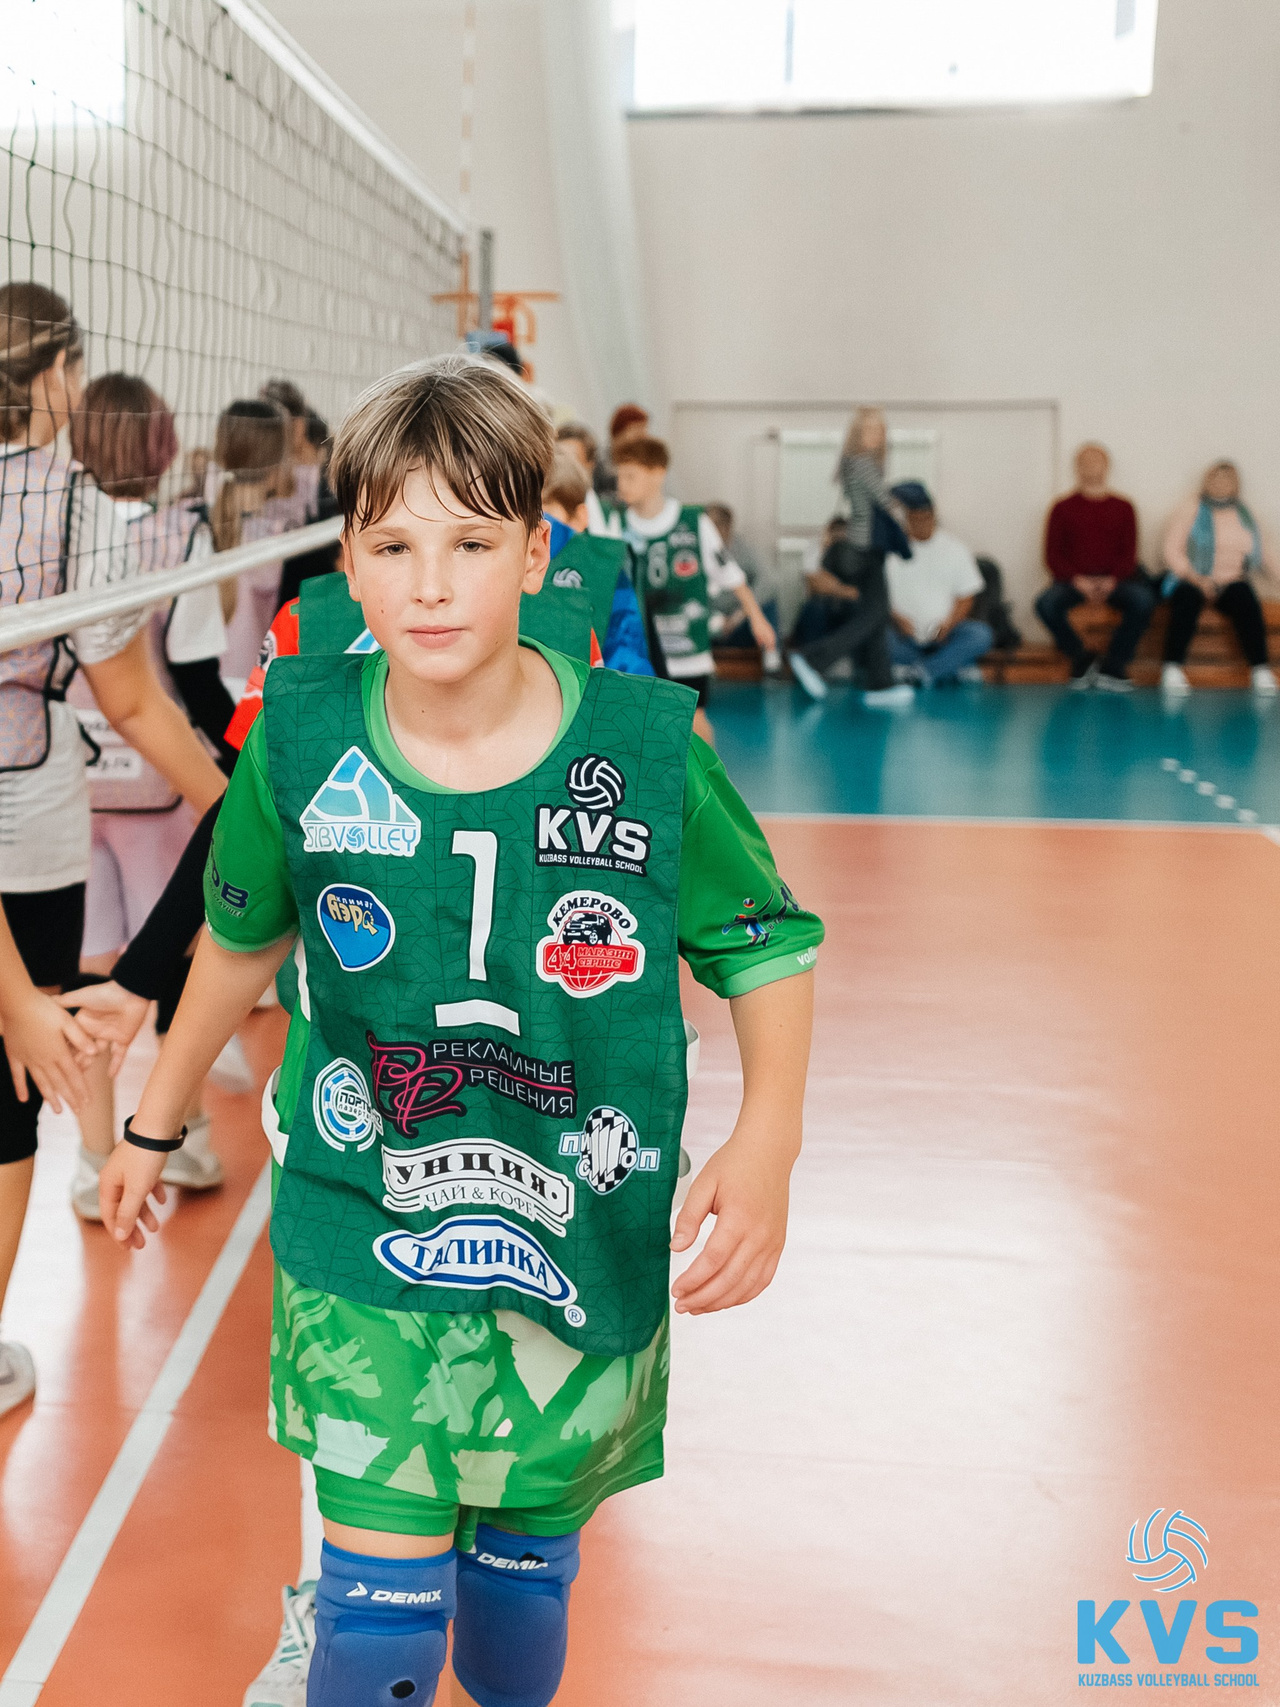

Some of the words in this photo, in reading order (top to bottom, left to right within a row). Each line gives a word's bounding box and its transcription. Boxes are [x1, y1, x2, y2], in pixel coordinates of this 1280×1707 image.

[538, 807, 649, 861] KVS
[539, 853, 568, 864] KUZBASS
[569, 855, 613, 868] VOLLEYBALL
[615, 860, 644, 875] SCHOOL
[553, 896, 631, 930] КЕМЕРОВО
[577, 947, 634, 960] МАГАЗИН
[577, 958, 622, 969] СЕРВИС
[433, 1042, 573, 1084] РЕКЛАМНЫЕ
[470, 1069, 574, 1115] РЕШЕНИЯ
[393, 1152, 548, 1201] УНЦИЯ
[425, 1184, 466, 1207] ЧАЙ
[472, 1187, 484, 1200] &
[489, 1187, 535, 1217] КОФЕ
[411, 1238, 549, 1290] ТАЛИНКА
[371, 1589, 442, 1604] DEMIX
